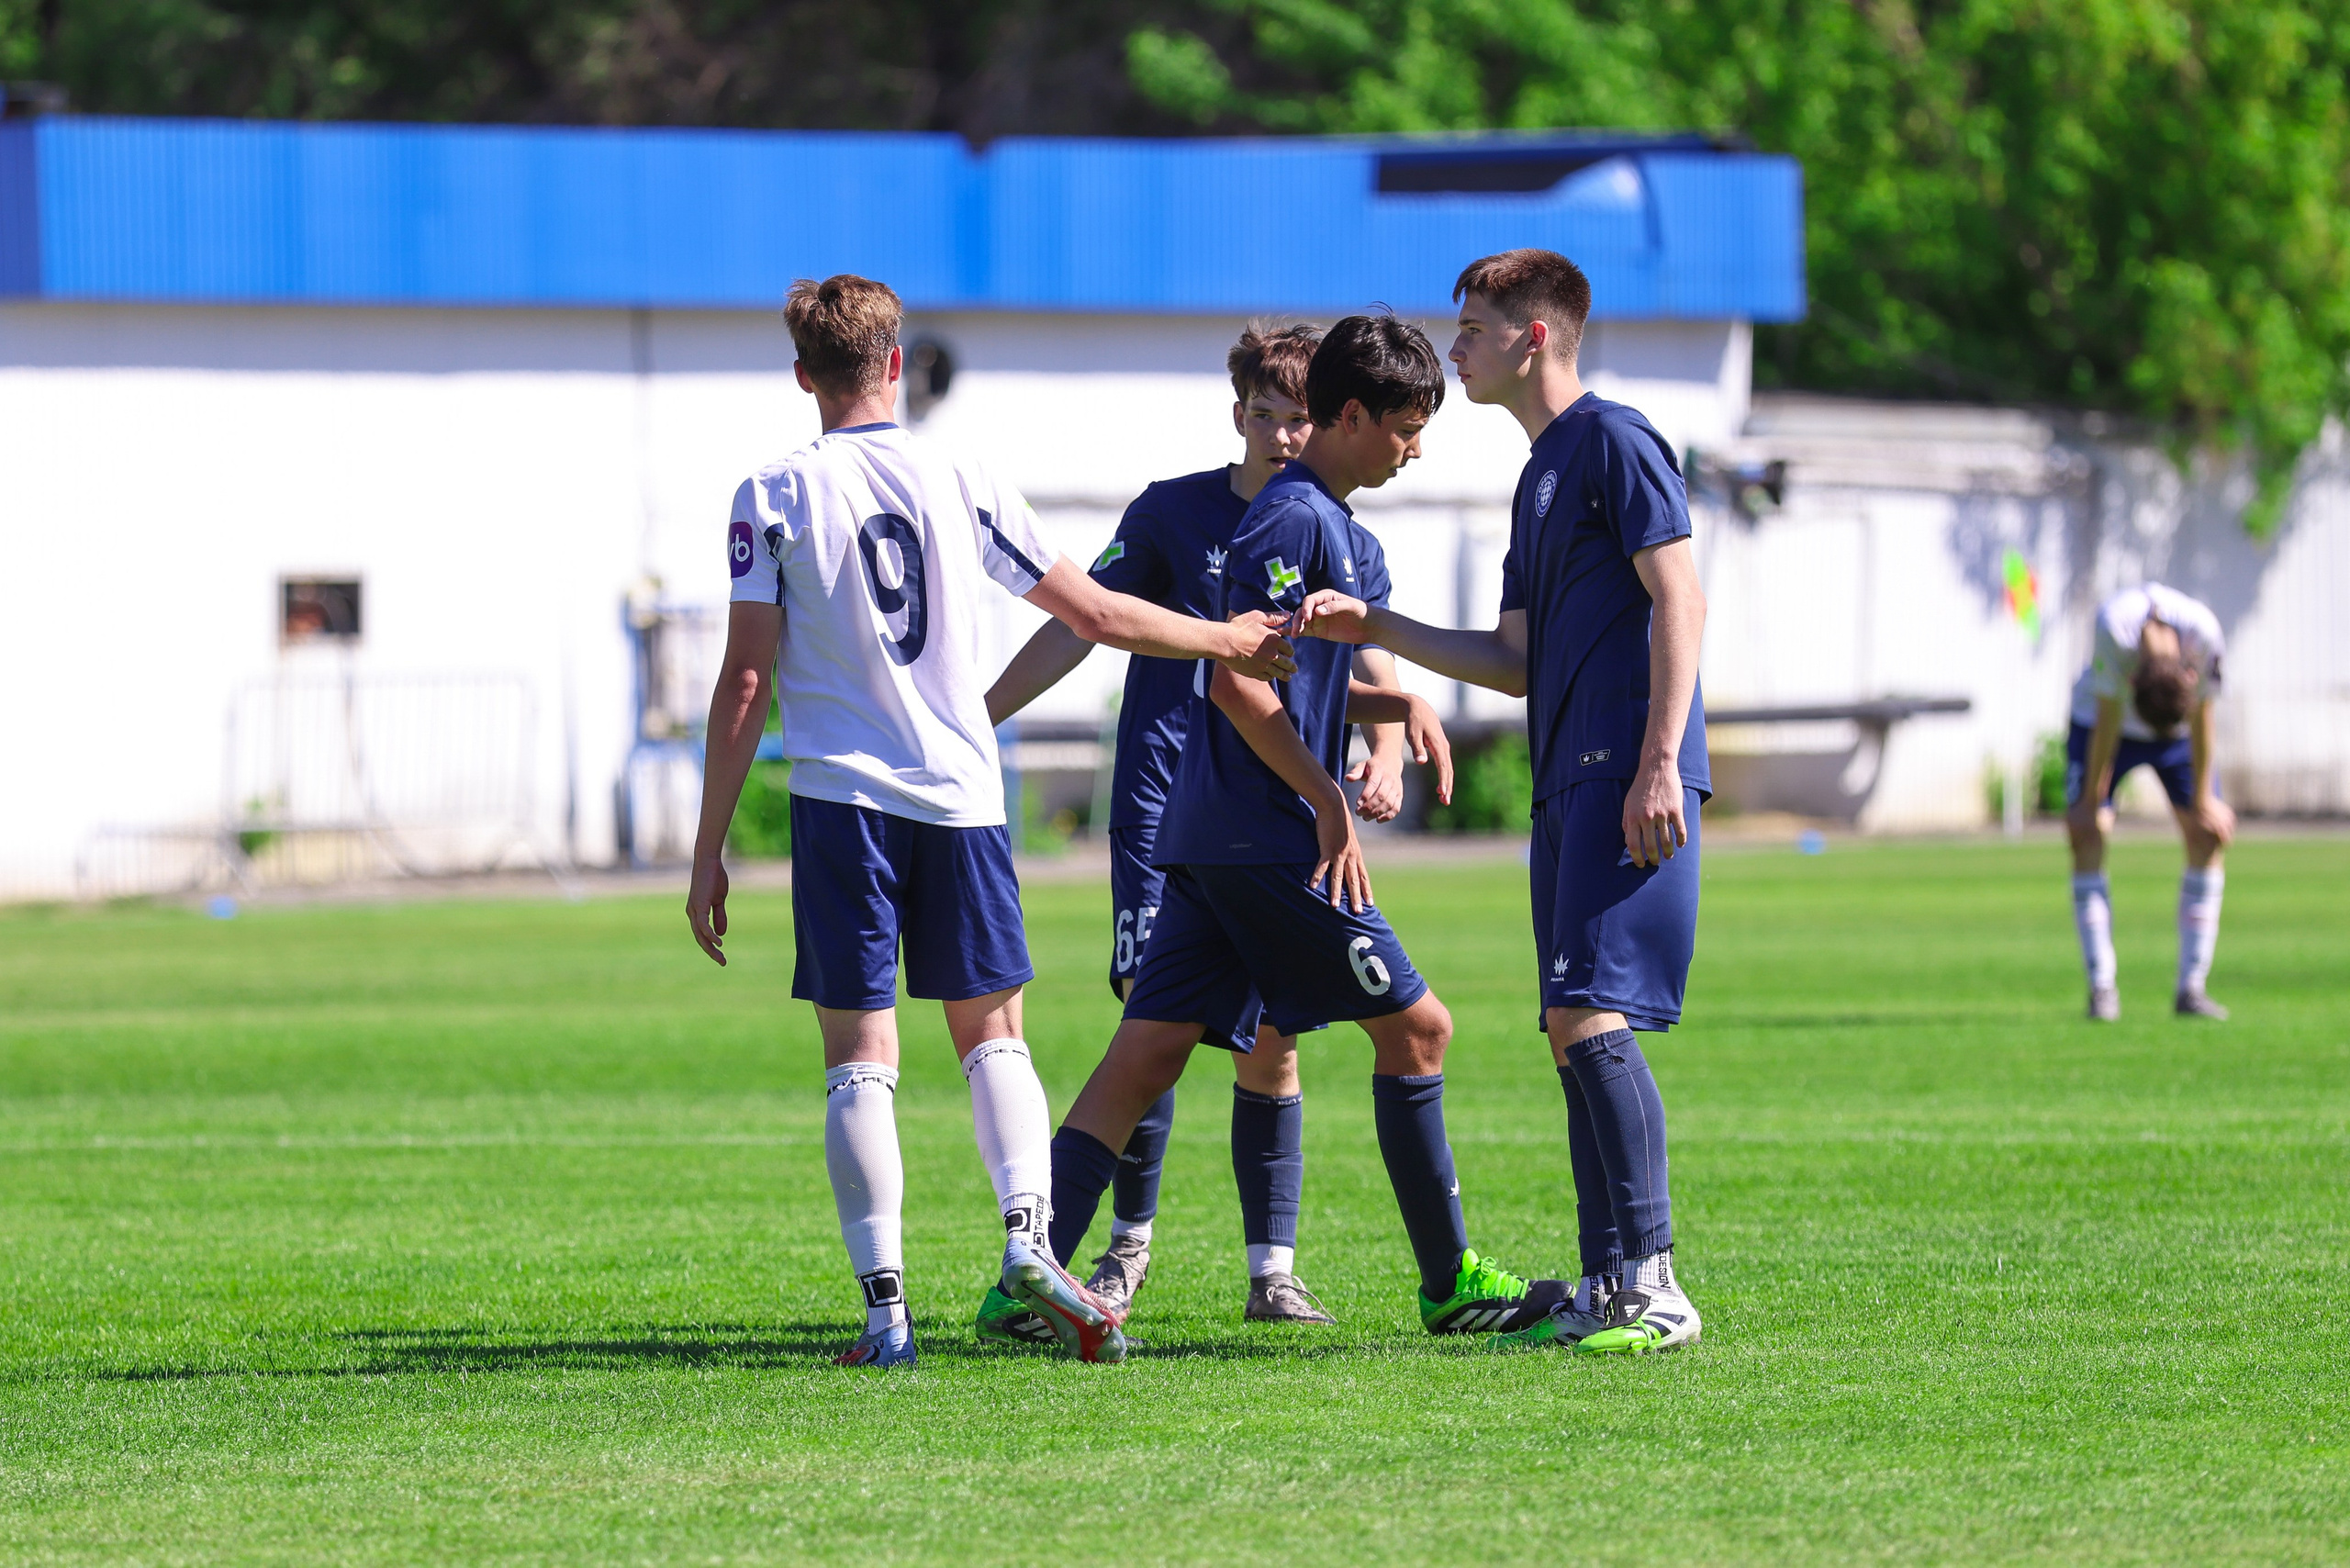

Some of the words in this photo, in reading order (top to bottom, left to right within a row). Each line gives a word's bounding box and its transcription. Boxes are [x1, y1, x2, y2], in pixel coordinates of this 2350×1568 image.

[858, 513, 928, 666] 9
[1116, 906, 1159, 973] 65
[1348, 935, 1391, 996] 6
